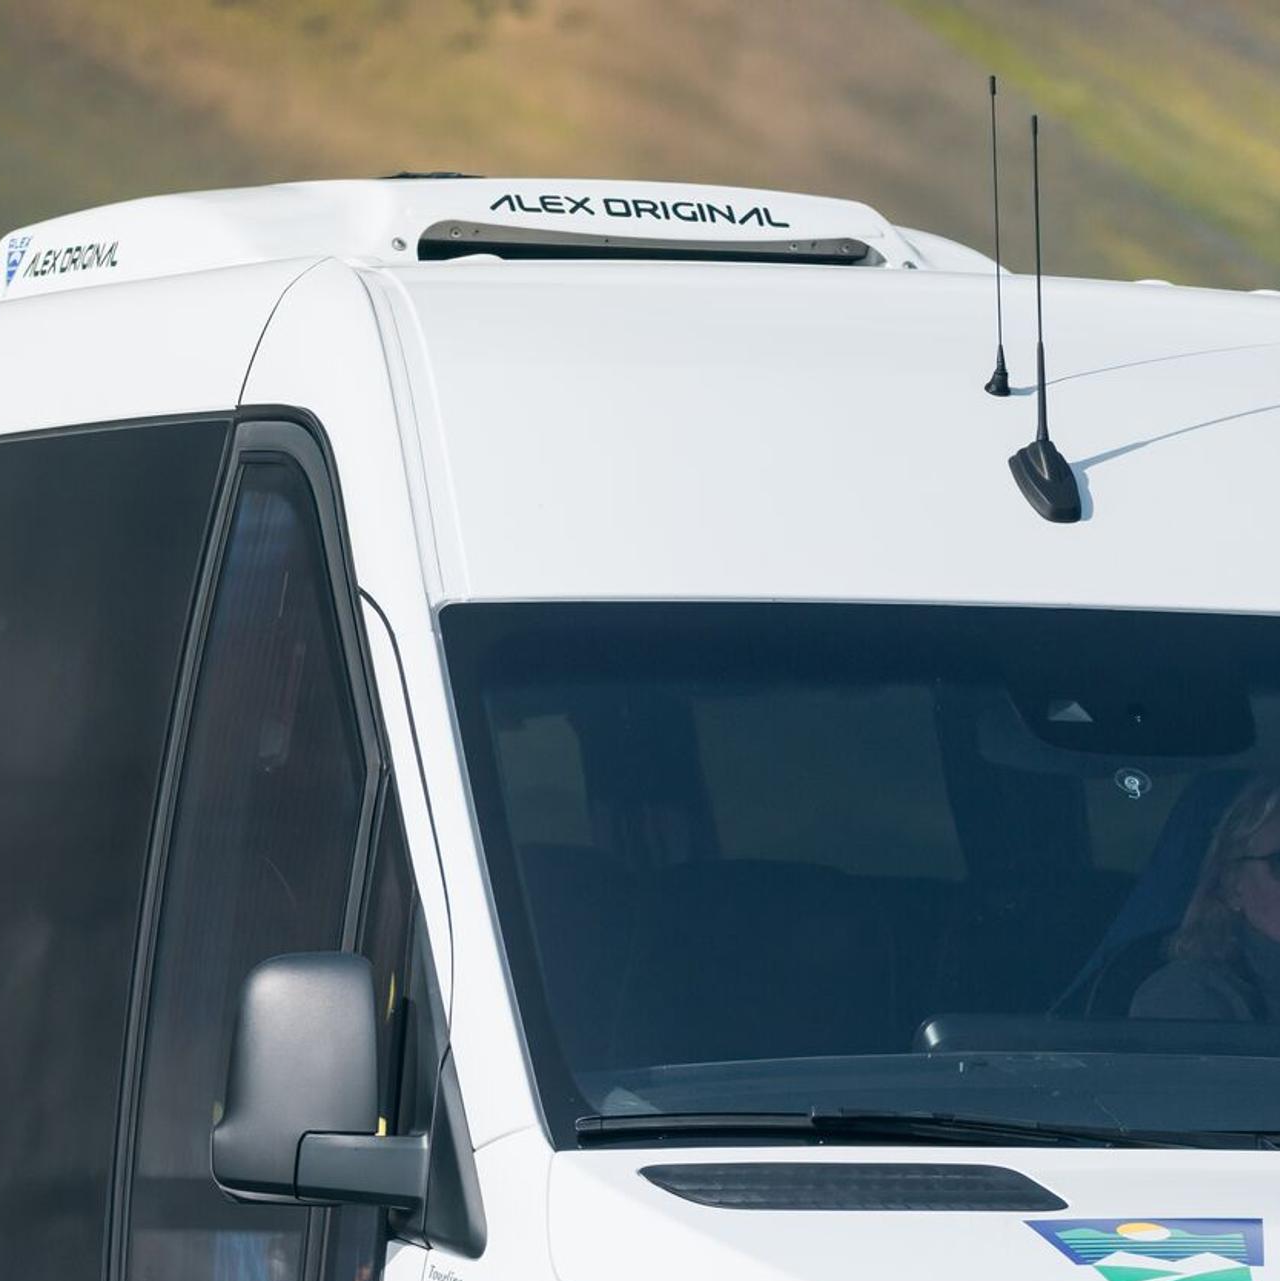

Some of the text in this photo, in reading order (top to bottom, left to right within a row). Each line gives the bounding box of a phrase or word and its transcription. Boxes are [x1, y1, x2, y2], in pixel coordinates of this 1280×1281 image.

[490, 194, 790, 228] ALEX ORIGINAL
[23, 241, 118, 278] ALEX ORIGINAL
